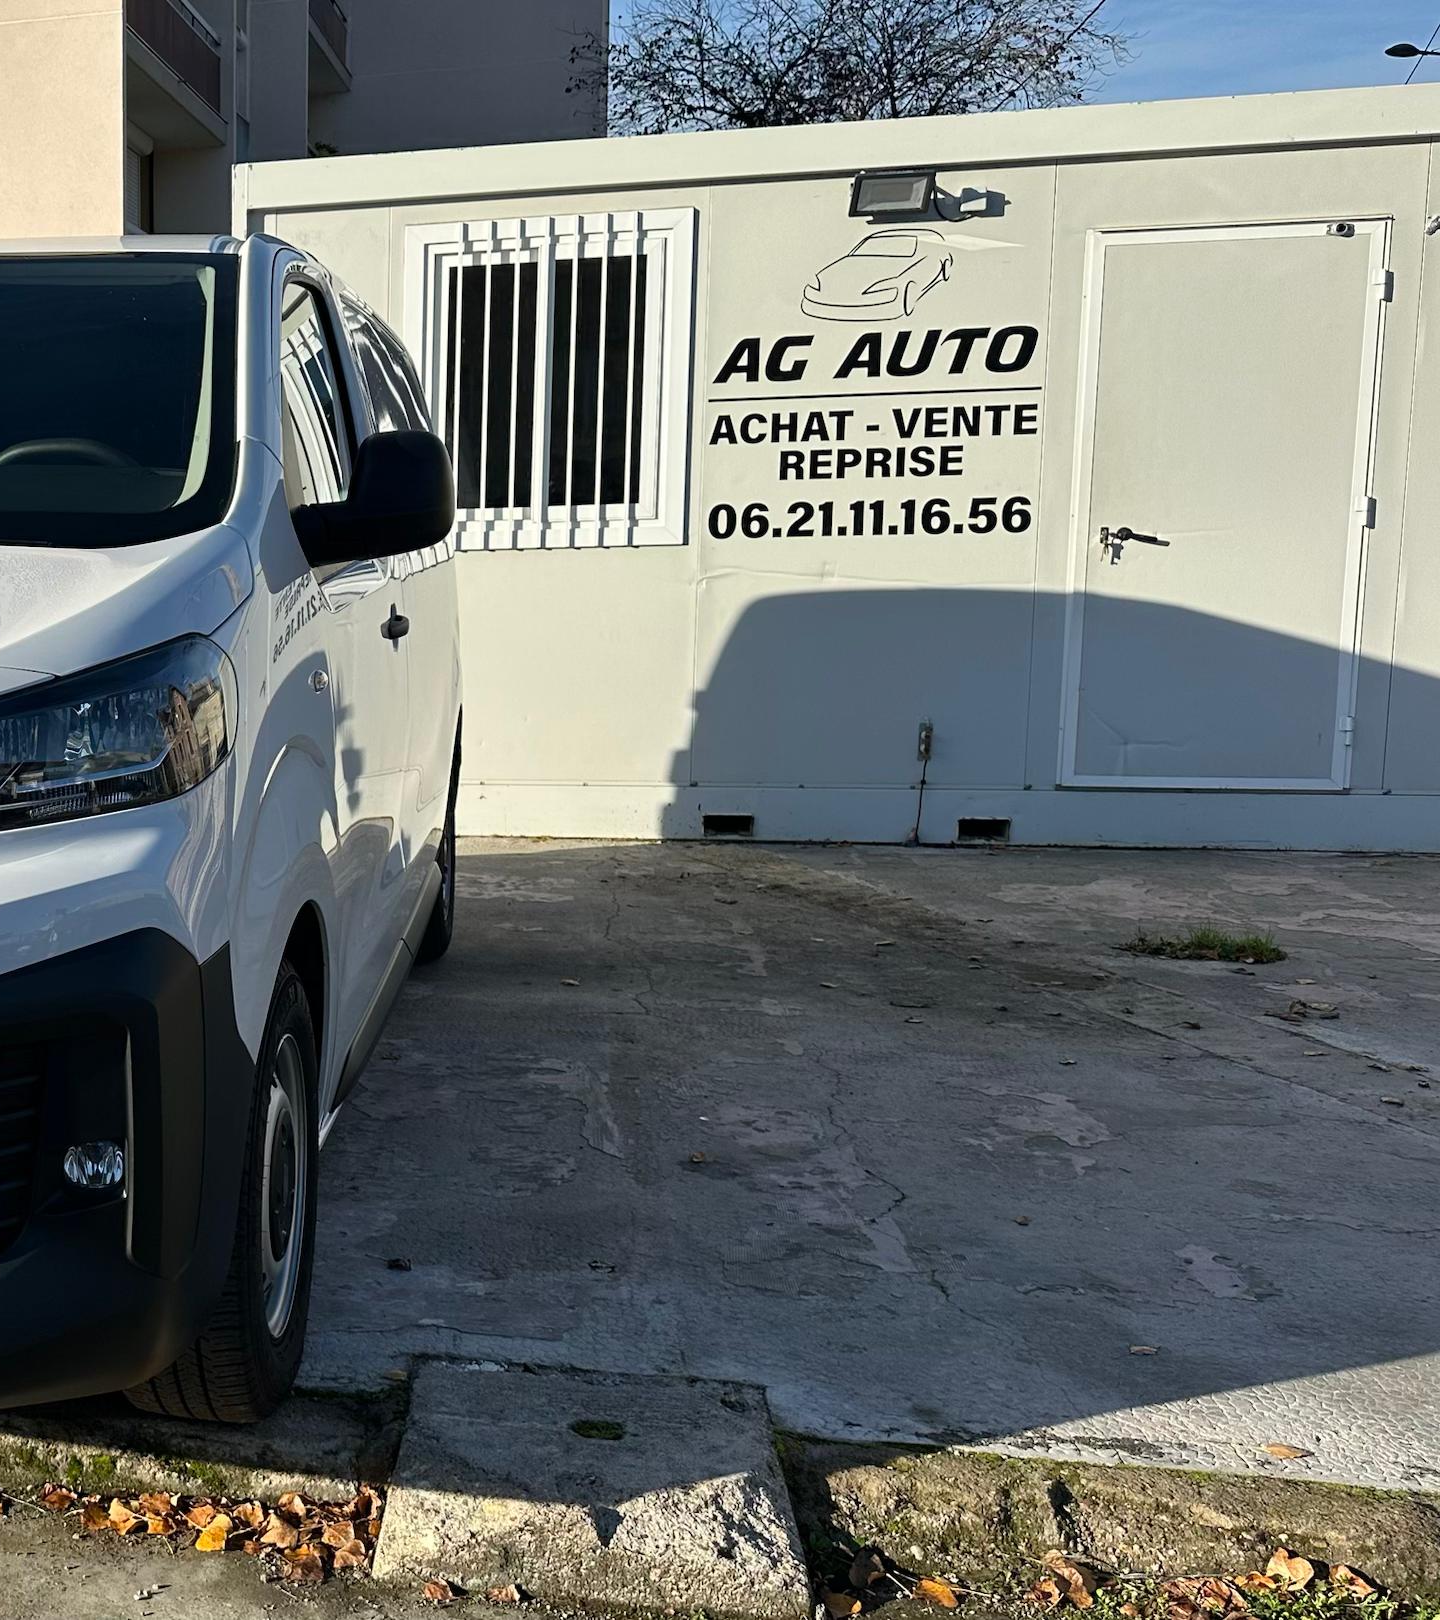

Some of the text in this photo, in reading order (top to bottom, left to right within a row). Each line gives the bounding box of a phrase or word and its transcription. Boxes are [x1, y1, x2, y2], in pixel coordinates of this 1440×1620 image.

[712, 325, 1039, 384] AG AUTO
[709, 410, 854, 445] ACHAT
[892, 403, 1038, 439] VENTE
[779, 445, 963, 480] REPRISE
[708, 496, 1031, 540] 06.21.11.16.56
